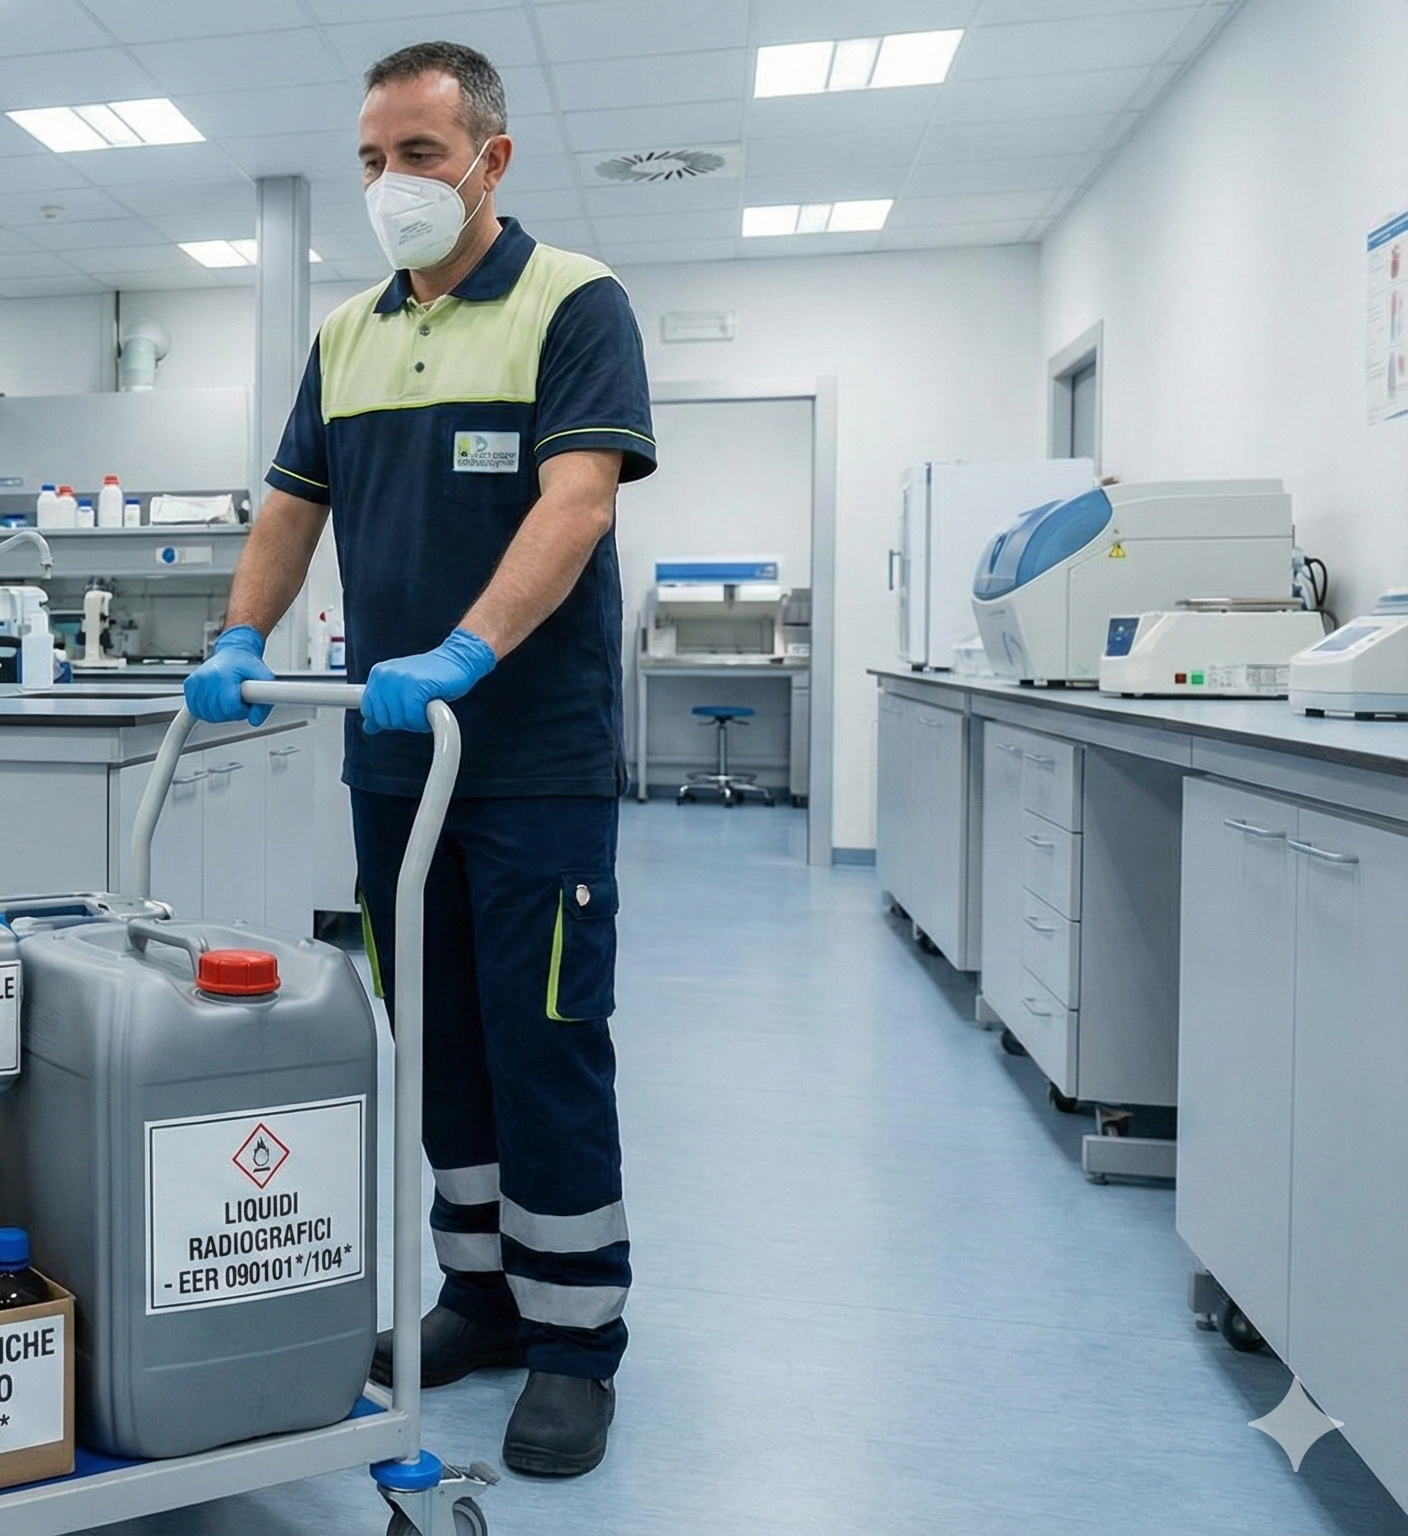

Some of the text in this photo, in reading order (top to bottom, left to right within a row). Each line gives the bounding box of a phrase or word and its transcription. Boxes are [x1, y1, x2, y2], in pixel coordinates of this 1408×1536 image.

[224, 1191, 298, 1225] LIQUIDI
[189, 1216, 331, 1261] RADIOGRAFICI
[179, 1267, 219, 1294] EER
